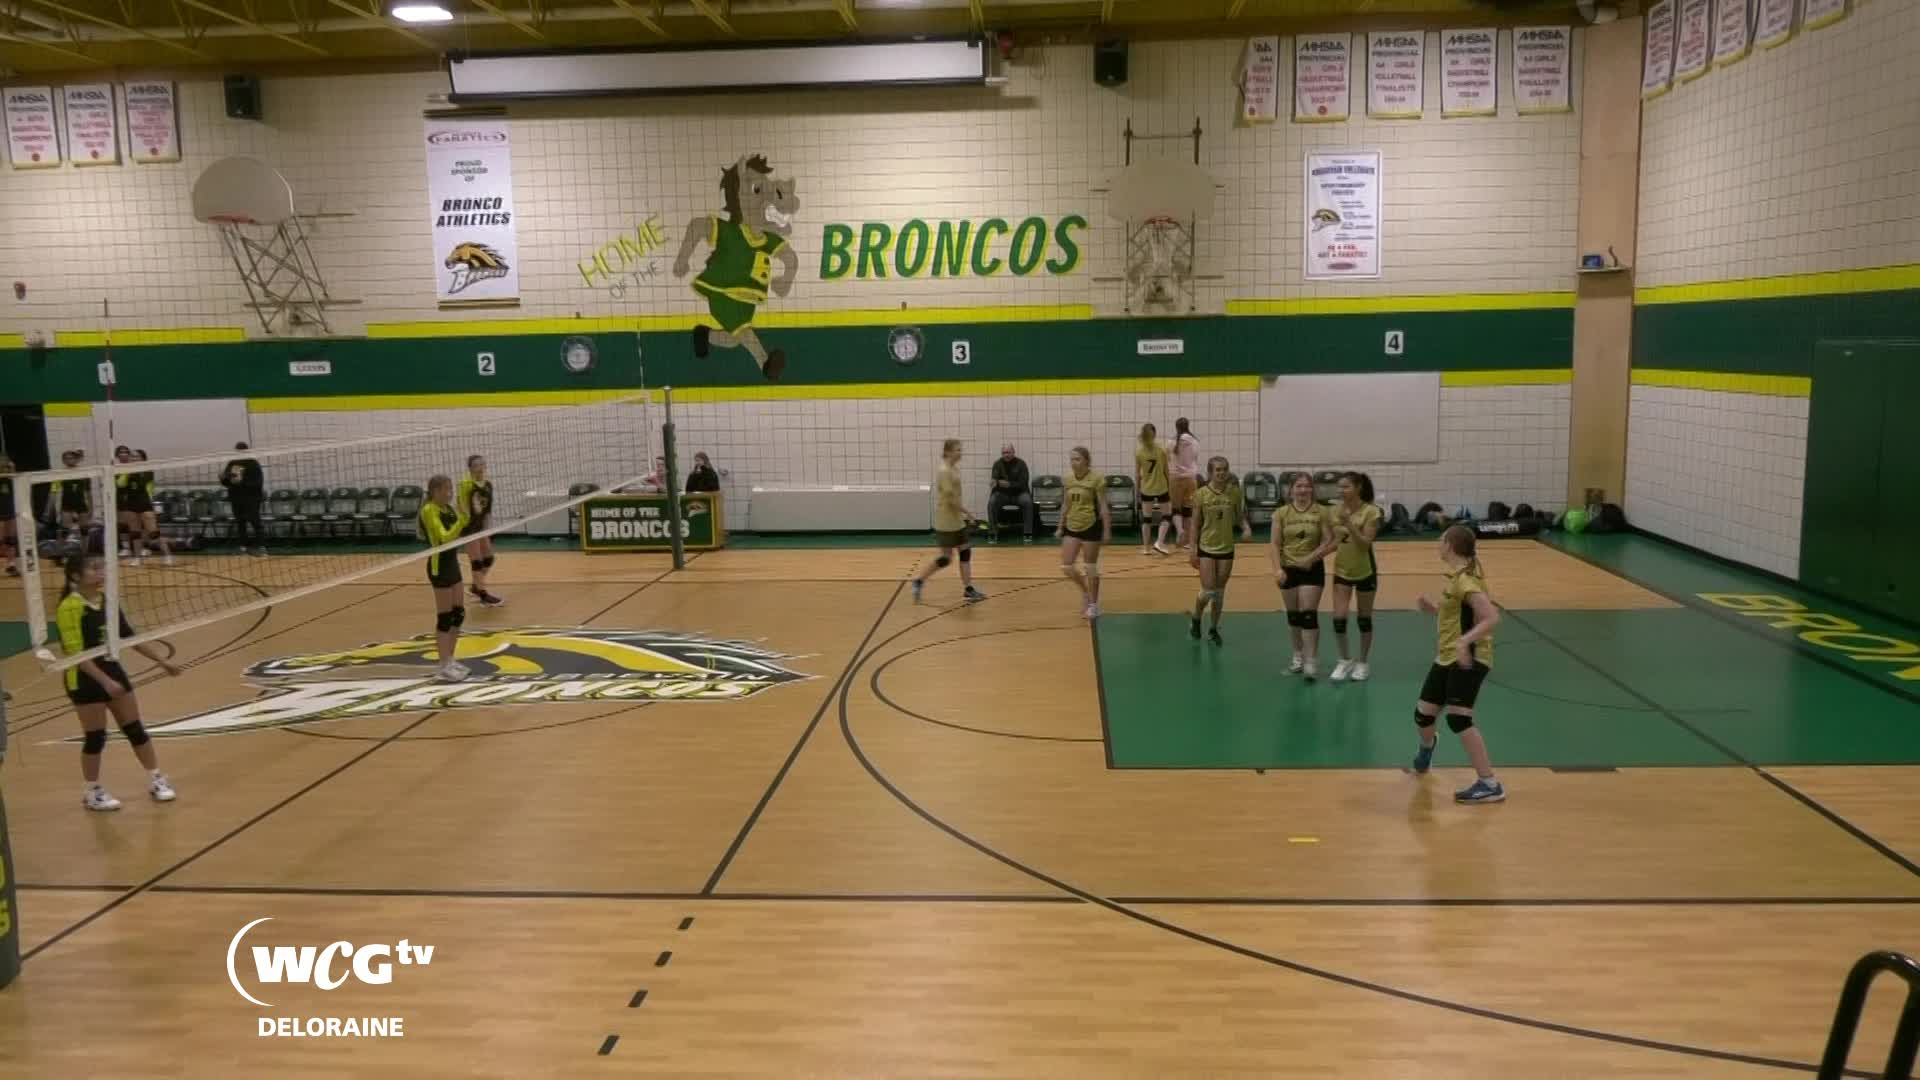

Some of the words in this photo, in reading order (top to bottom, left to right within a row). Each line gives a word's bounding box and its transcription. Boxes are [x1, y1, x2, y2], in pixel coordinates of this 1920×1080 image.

[442, 197, 503, 213] BRONCO
[436, 213, 511, 228] ATHLETICS
[576, 217, 668, 288] HOME
[818, 214, 1088, 280] BRONCOS
[608, 281, 627, 300] OF
[632, 261, 659, 287] THE
[1388, 333, 1400, 352] 4
[954, 344, 967, 362] 3
[480, 355, 493, 372] 2
[1146, 459, 1157, 474] 7
[1071, 493, 1081, 502] 11
[591, 507, 621, 518] HOME
[622, 507, 637, 518] OF
[638, 506, 660, 518] THE
[140, 678, 775, 736] BRONCOS
